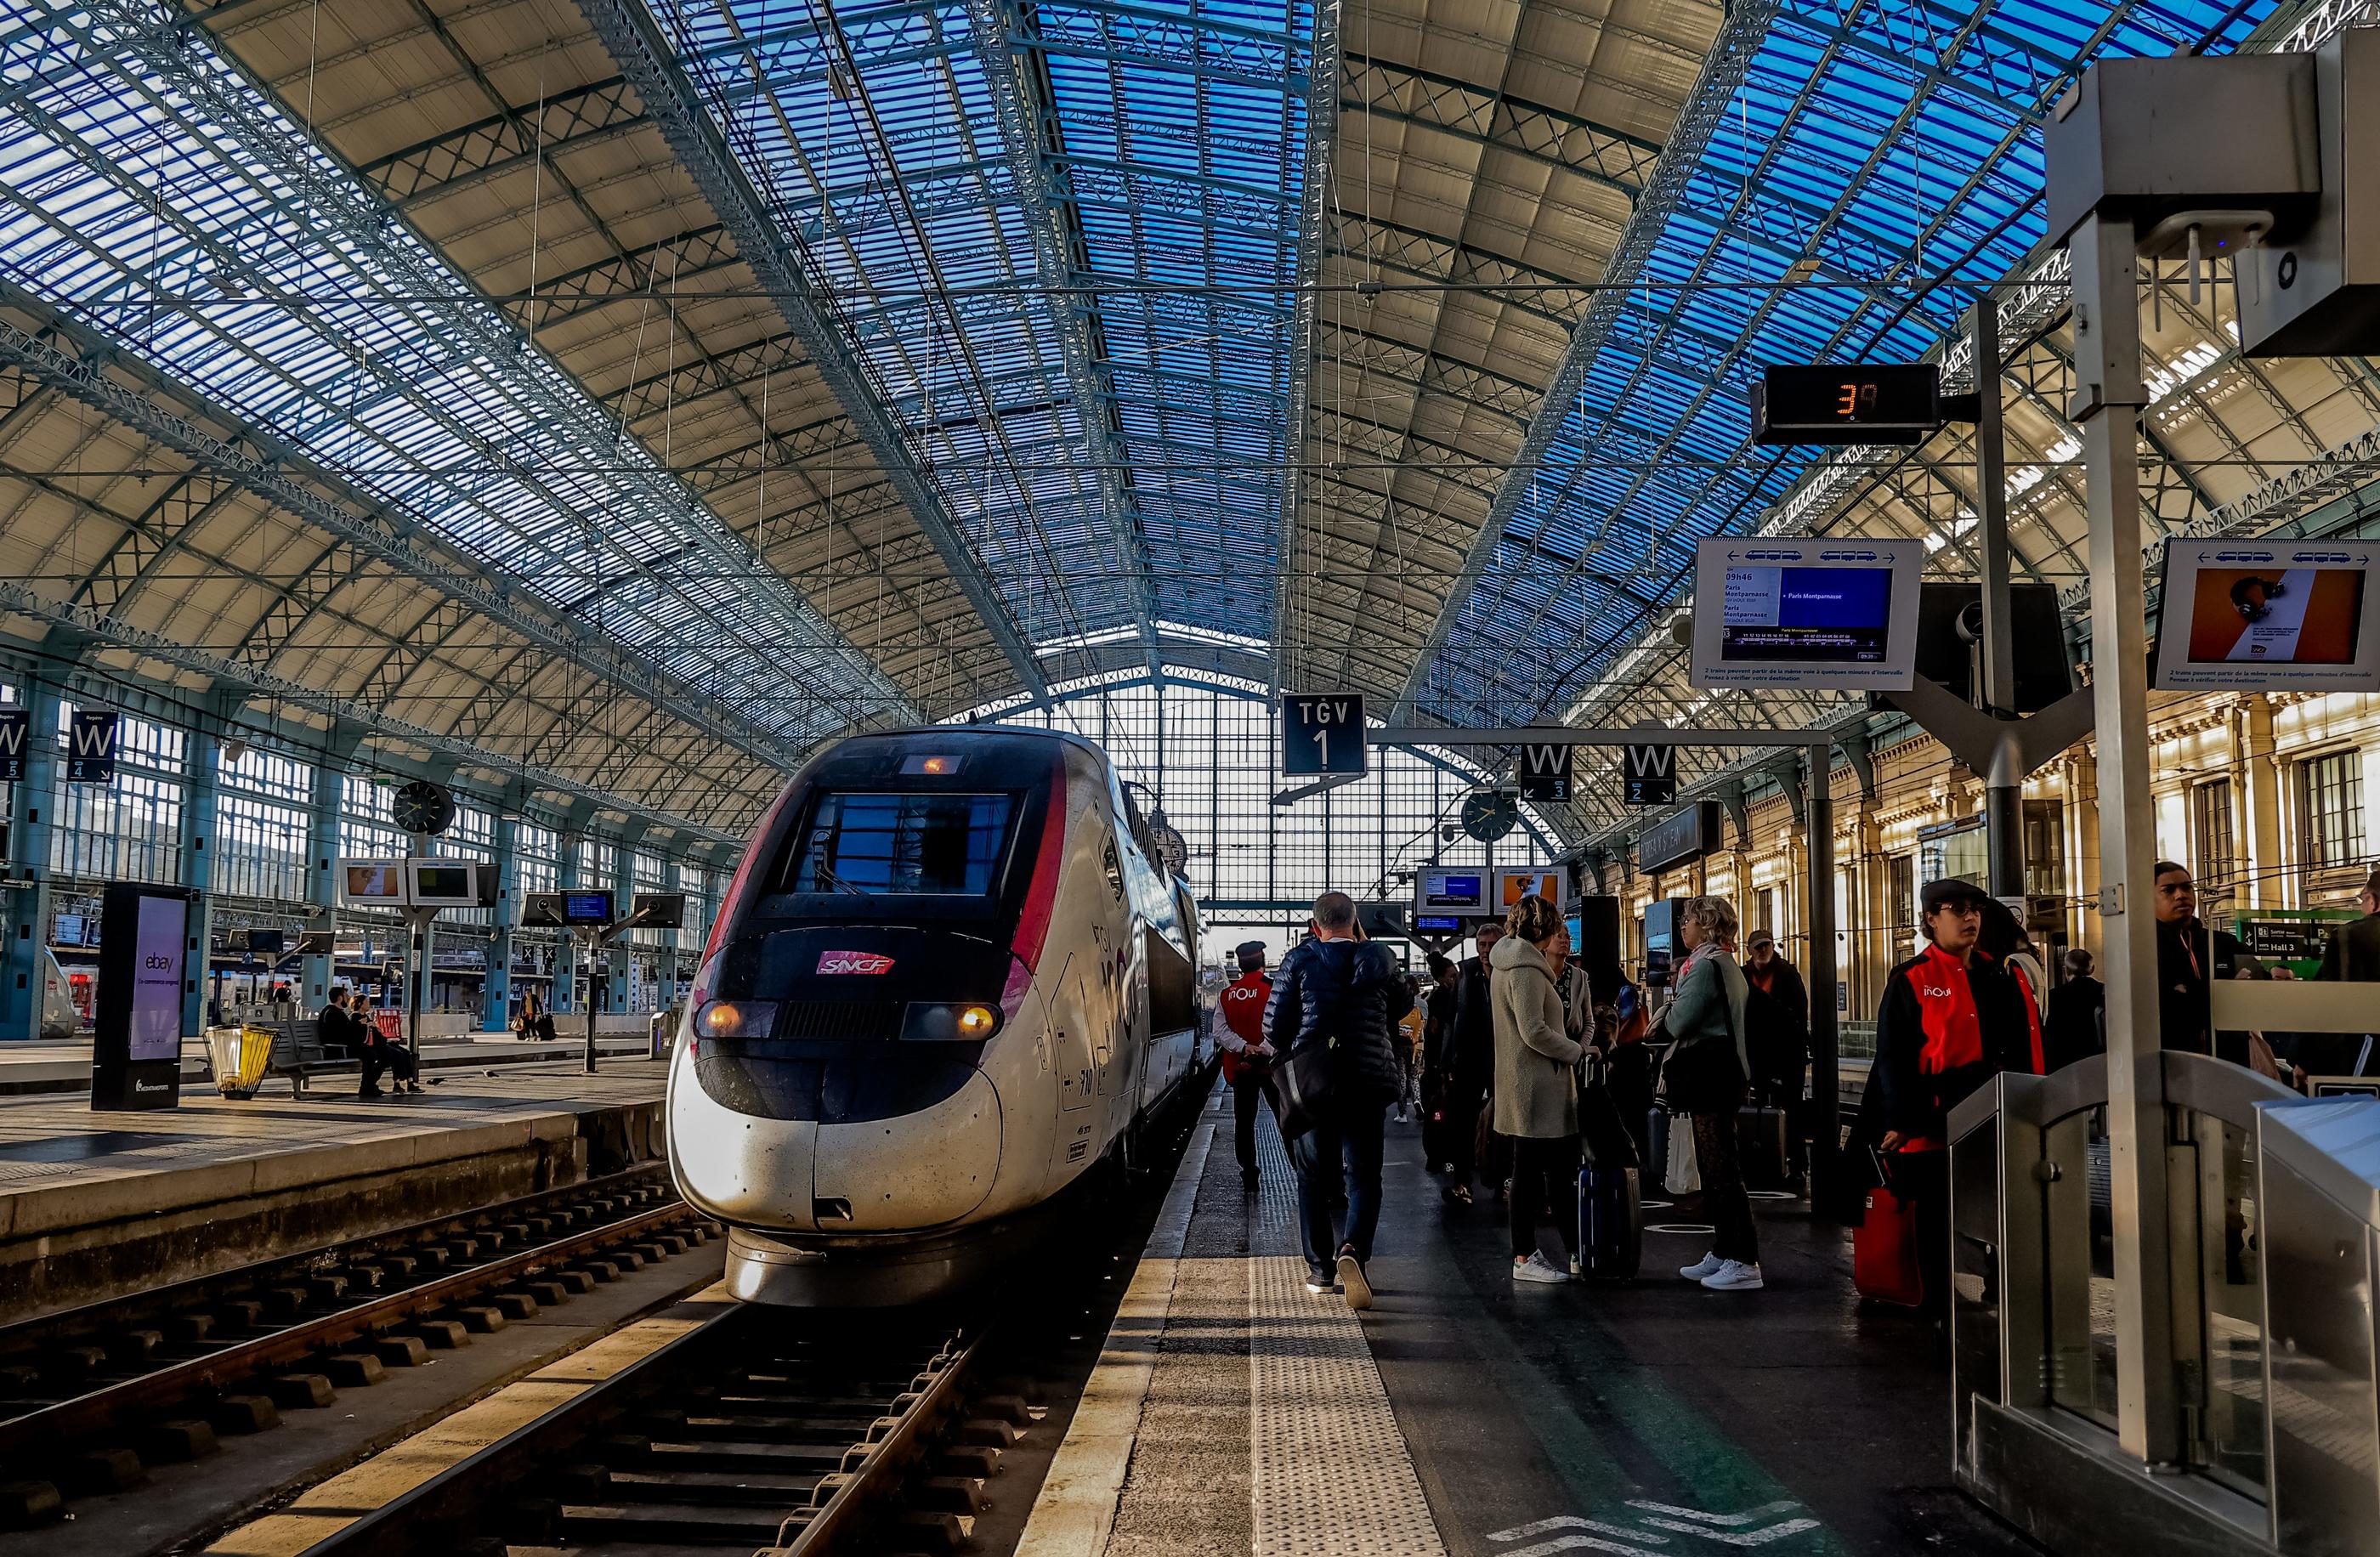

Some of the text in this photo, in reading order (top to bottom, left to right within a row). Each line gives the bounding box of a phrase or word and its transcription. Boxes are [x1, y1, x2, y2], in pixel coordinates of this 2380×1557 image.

[1299, 702, 1348, 724] TGV
[74, 724, 115, 756] W
[1313, 729, 1328, 765] 1
[1527, 745, 1568, 774] W
[1629, 745, 1673, 777] W
[9, 766, 17, 776] 5
[75, 767, 82, 777] 4
[1556, 786, 1563, 798] 3
[1633, 789, 1641, 800] 2
[145, 952, 174, 974] ebay
[820, 960, 890, 971] SNCF
[1924, 987, 1952, 997] inOui
